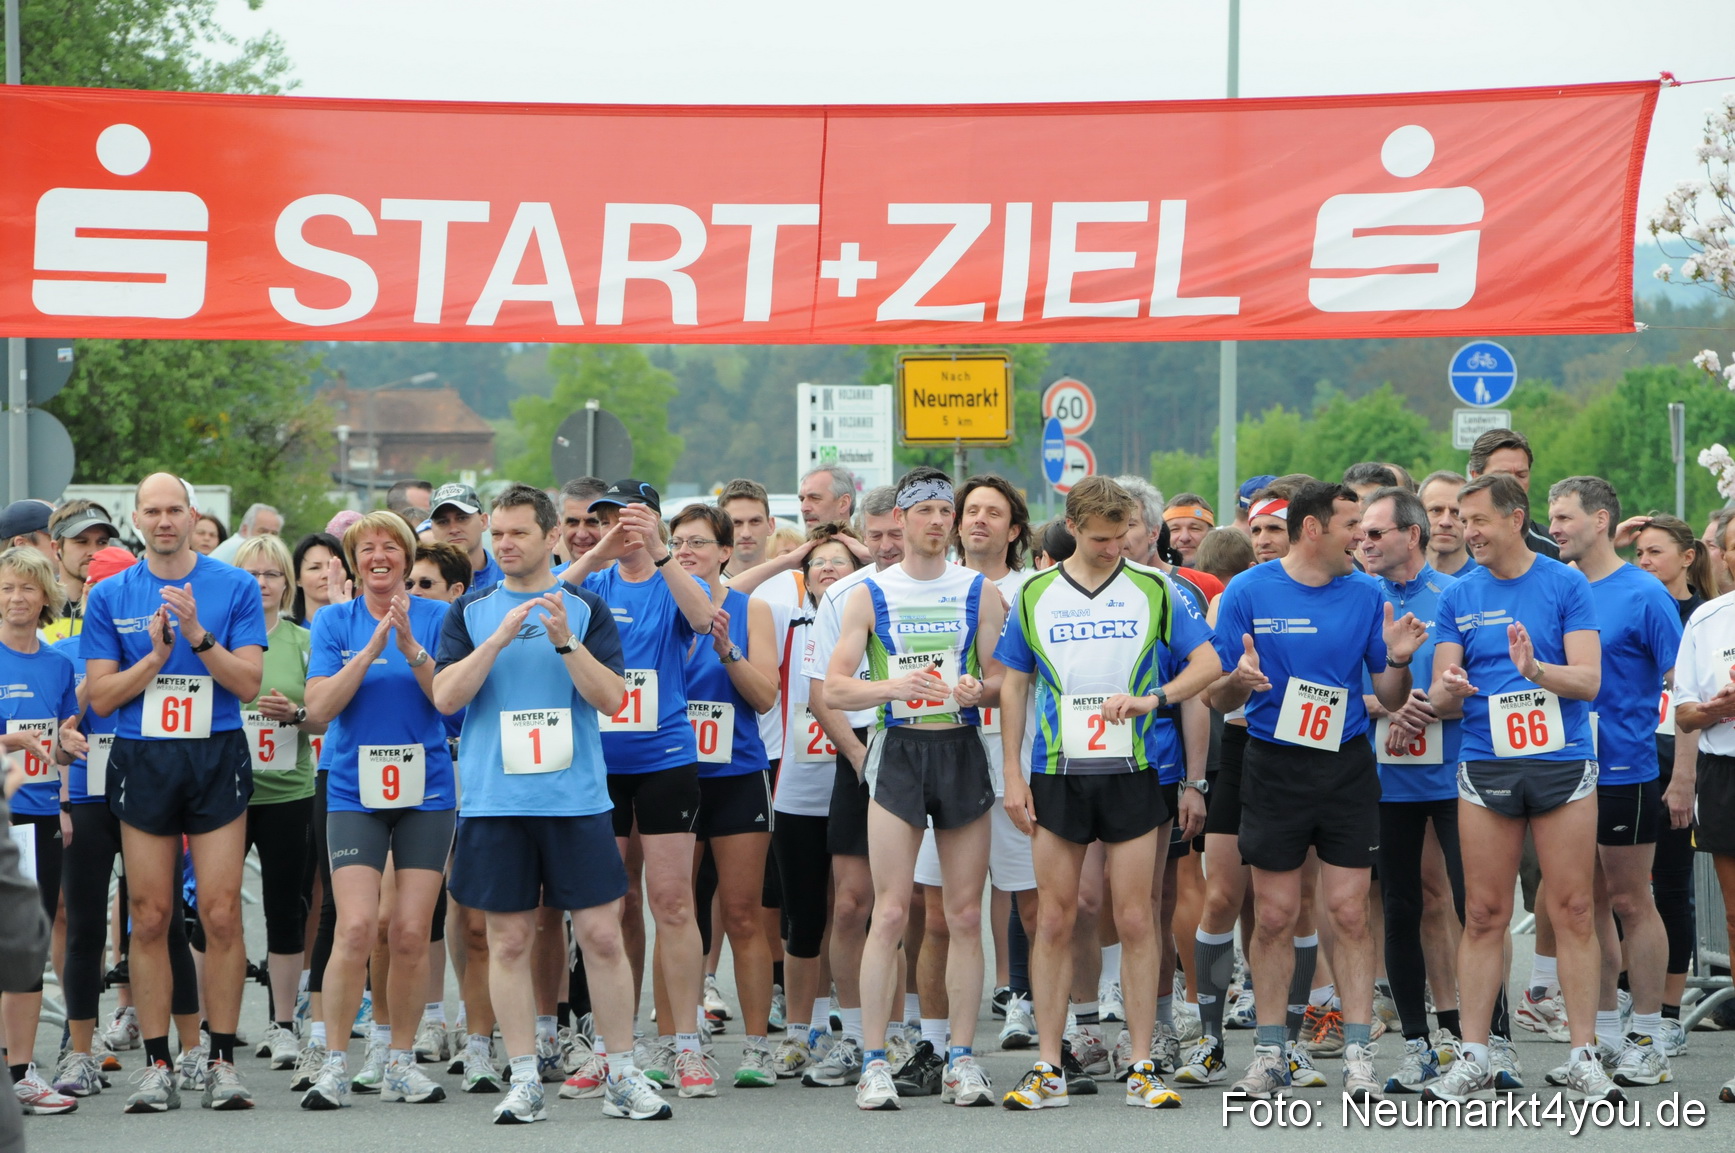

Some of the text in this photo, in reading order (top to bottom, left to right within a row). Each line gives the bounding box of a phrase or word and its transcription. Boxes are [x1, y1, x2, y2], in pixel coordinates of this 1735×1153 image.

[941, 371, 971, 382] Nach
[913, 388, 999, 408] Neumarkt
[1056, 396, 1084, 420] 60
[943, 415, 973, 426] 5 km
[1051, 608, 1091, 619] TEAM
[897, 620, 961, 634] BOCK
[1049, 620, 1139, 644] BOCK
[899, 654, 930, 665] MEYER
[156, 677, 186, 686] MEYER
[1298, 691, 1328, 704] WERBUNG
[1299, 683, 1330, 698] MEYER
[611, 688, 642, 723] 21
[1072, 696, 1104, 706] MEYER
[1500, 693, 1531, 704] MEYER
[1500, 701, 1533, 710] WERBUNG
[161, 696, 193, 733] 61
[513, 712, 545, 721] MEYER
[1298, 702, 1332, 741] 16
[513, 719, 546, 727] WERBUNG
[1506, 709, 1549, 750] 66
[1087, 714, 1107, 751] 2
[258, 729, 275, 763] 5
[369, 749, 401, 757] MEYER
[528, 728, 542, 764] 1
[25, 739, 52, 777] 67
[382, 764, 400, 801] 9
